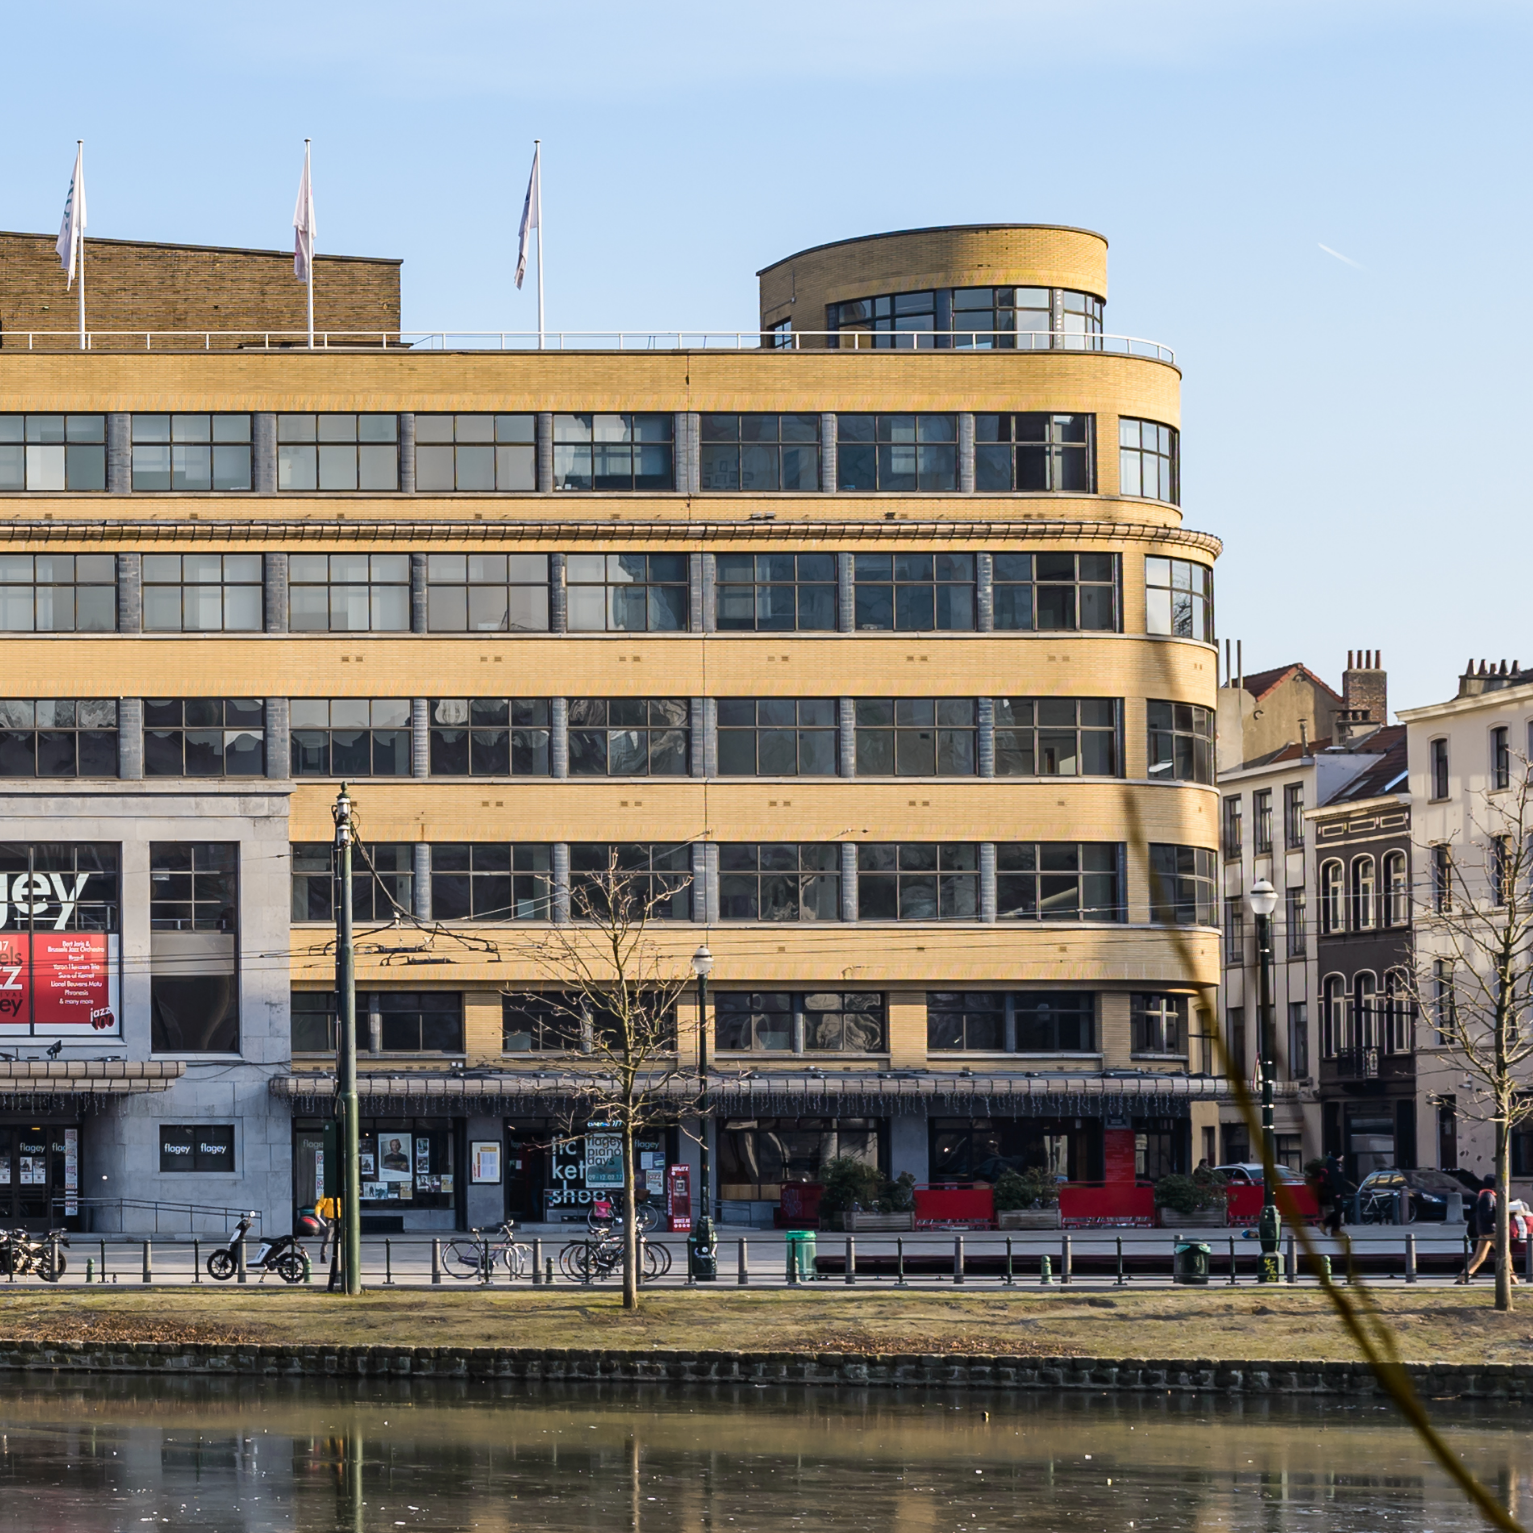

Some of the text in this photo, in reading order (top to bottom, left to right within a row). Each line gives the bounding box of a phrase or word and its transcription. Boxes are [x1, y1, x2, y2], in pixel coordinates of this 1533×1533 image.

[90, 1007, 111, 1022] jazz
[93, 1014, 114, 1030] 100
[20, 1143, 45, 1154] flagey
[165, 1143, 226, 1154] flagey flagey
[303, 1139, 324, 1149] flage
[634, 1139, 659, 1150] flagey
[588, 1148, 622, 1157] piano
[587, 1156, 614, 1167] days
[552, 1156, 586, 1179] ket
